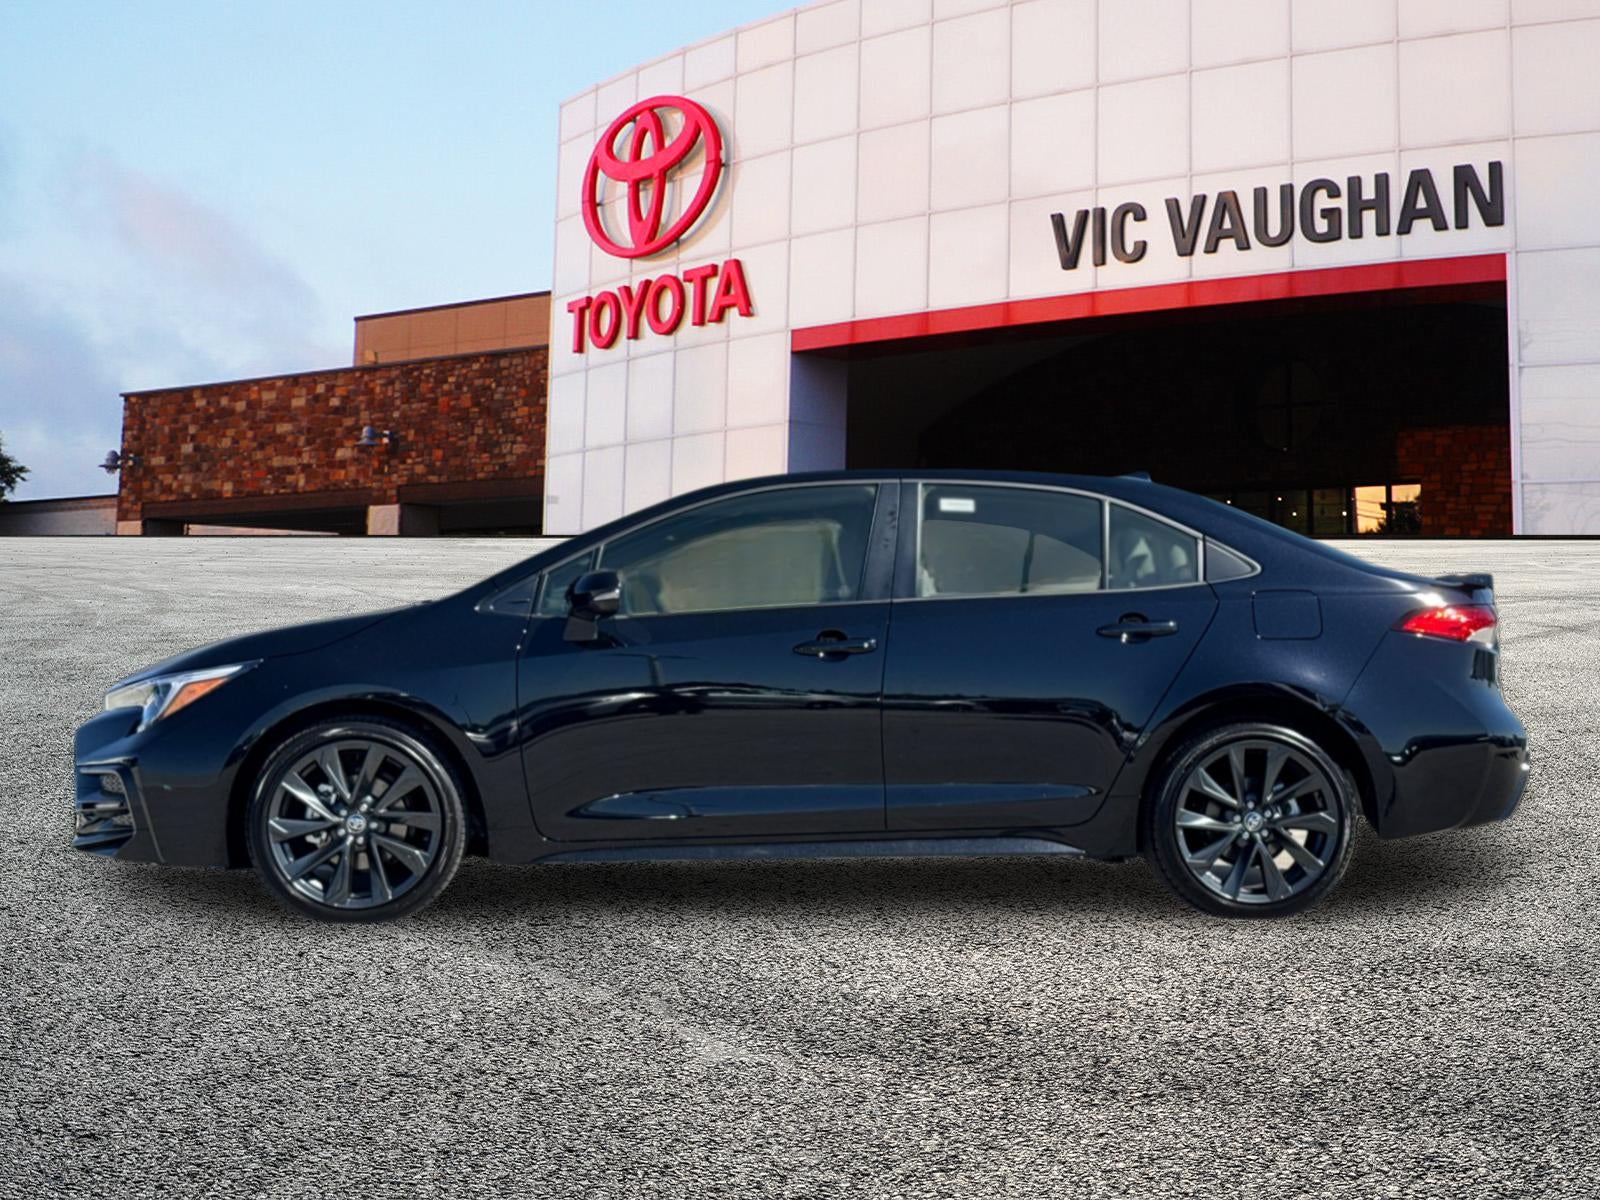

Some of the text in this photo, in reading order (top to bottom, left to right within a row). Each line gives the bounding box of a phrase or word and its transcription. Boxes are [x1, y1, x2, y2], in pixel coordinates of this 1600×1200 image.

[1051, 160, 1505, 270] VIC VAUGHAN
[567, 258, 754, 353] TOYOTA
